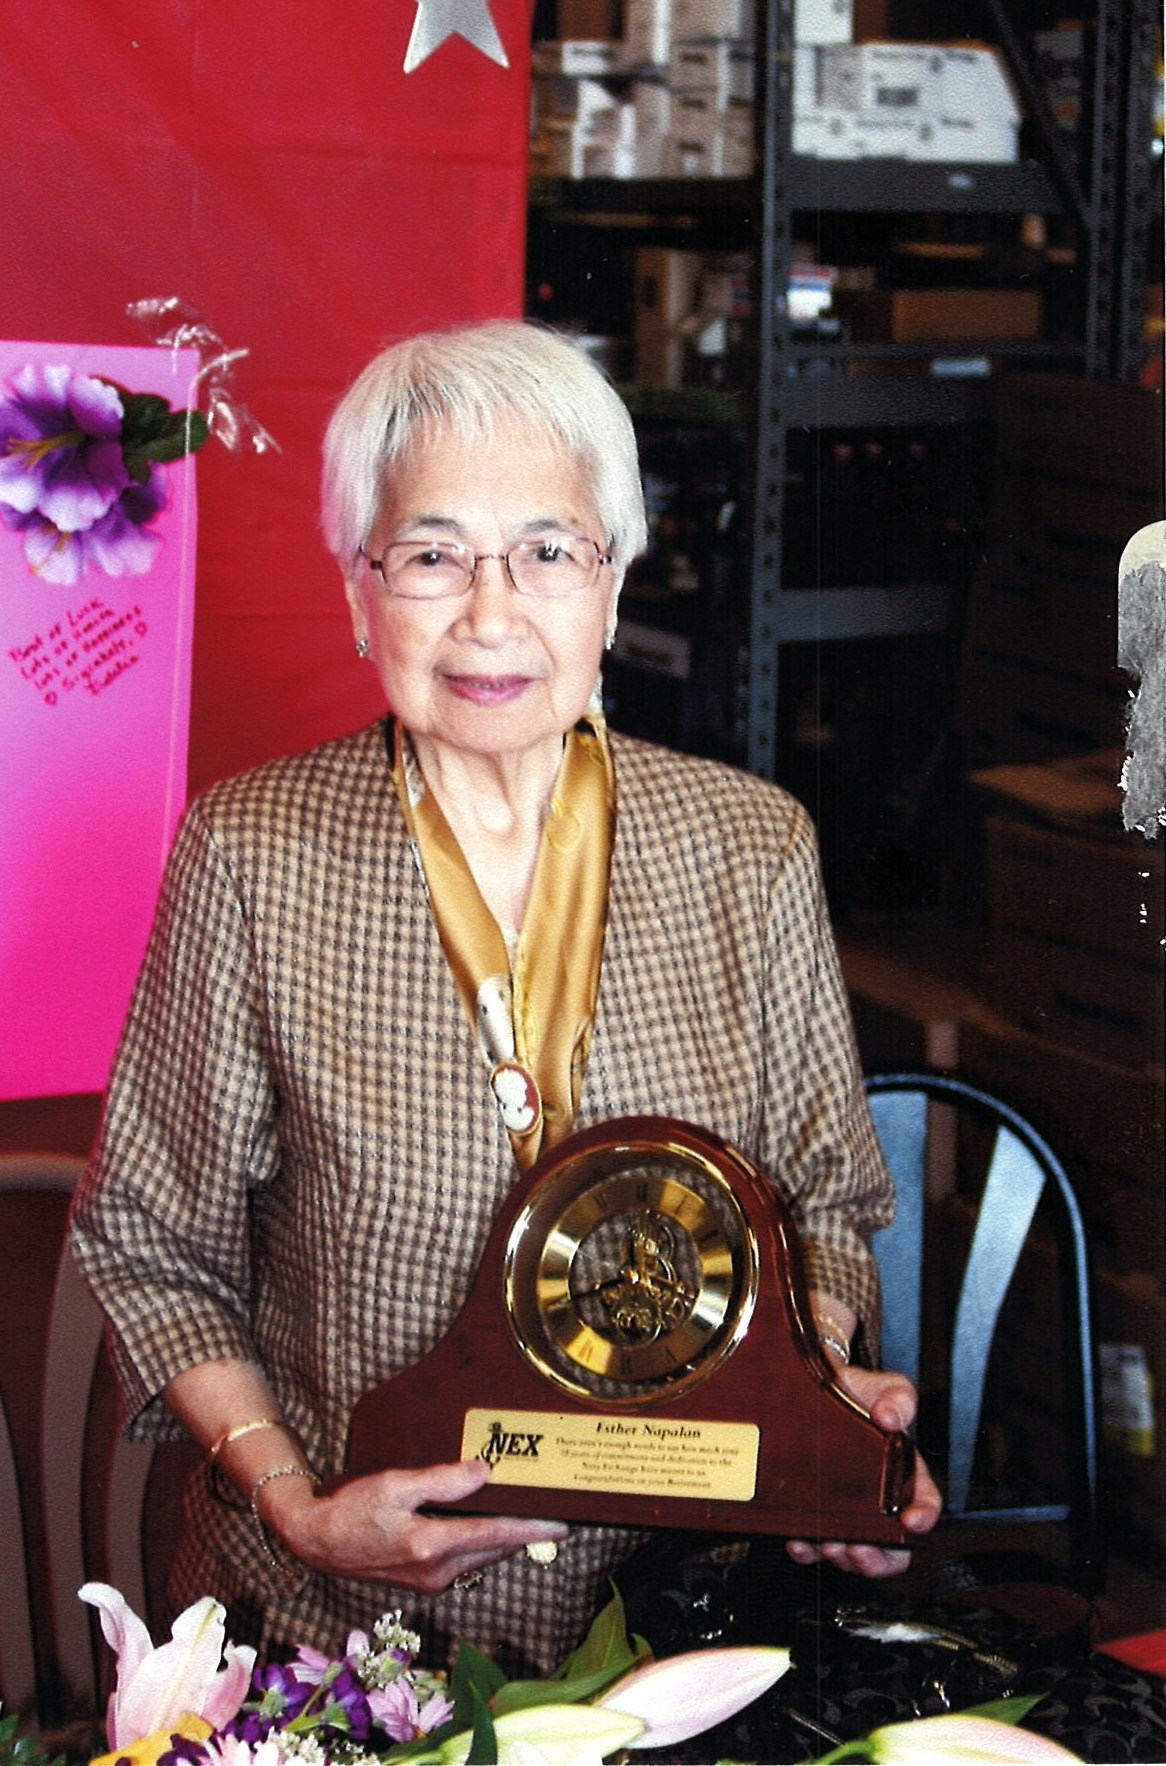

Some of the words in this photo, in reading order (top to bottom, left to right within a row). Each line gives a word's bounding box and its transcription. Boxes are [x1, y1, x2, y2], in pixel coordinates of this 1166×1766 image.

[48, 622, 62, 640] of
[597, 1422, 637, 1436] Esther
[643, 1423, 701, 1440] Napalan
[486, 1432, 544, 1457] NEX
